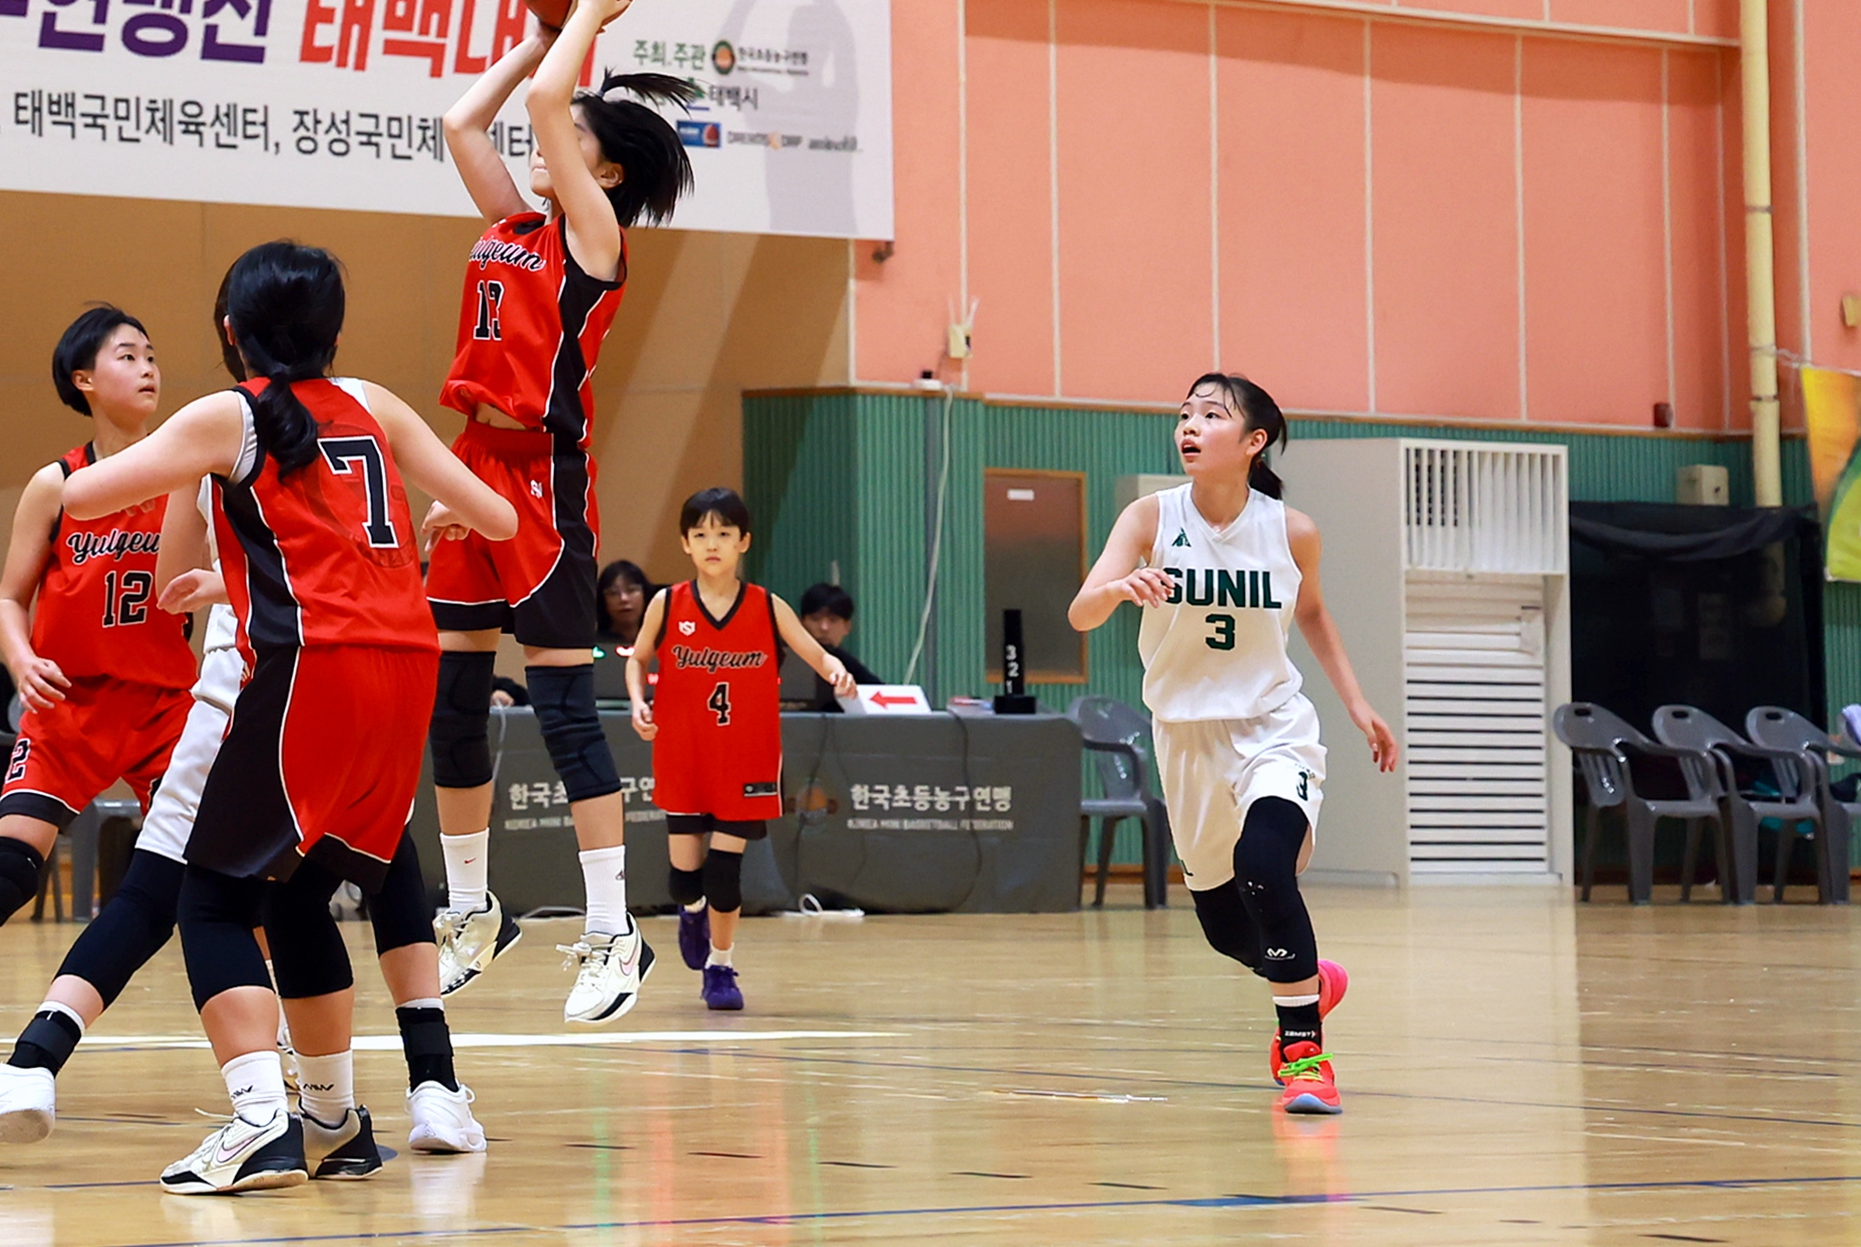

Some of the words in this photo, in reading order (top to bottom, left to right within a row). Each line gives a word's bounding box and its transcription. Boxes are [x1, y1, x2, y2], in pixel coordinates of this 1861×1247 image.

[709, 84, 759, 111] 태백시
[14, 88, 281, 156] 태백국민체육센터,
[316, 434, 400, 549] 7
[65, 527, 161, 565] Yulgeu
[102, 569, 154, 628] 12
[1160, 566, 1282, 609] SUNIL
[1205, 613, 1236, 651] 3
[672, 645, 768, 674] Yulgeum
[1005, 644, 1017, 661] 3
[1007, 661, 1019, 678] 2
[707, 681, 732, 727] 4
[850, 783, 1012, 812] 한국초등농구연맹
